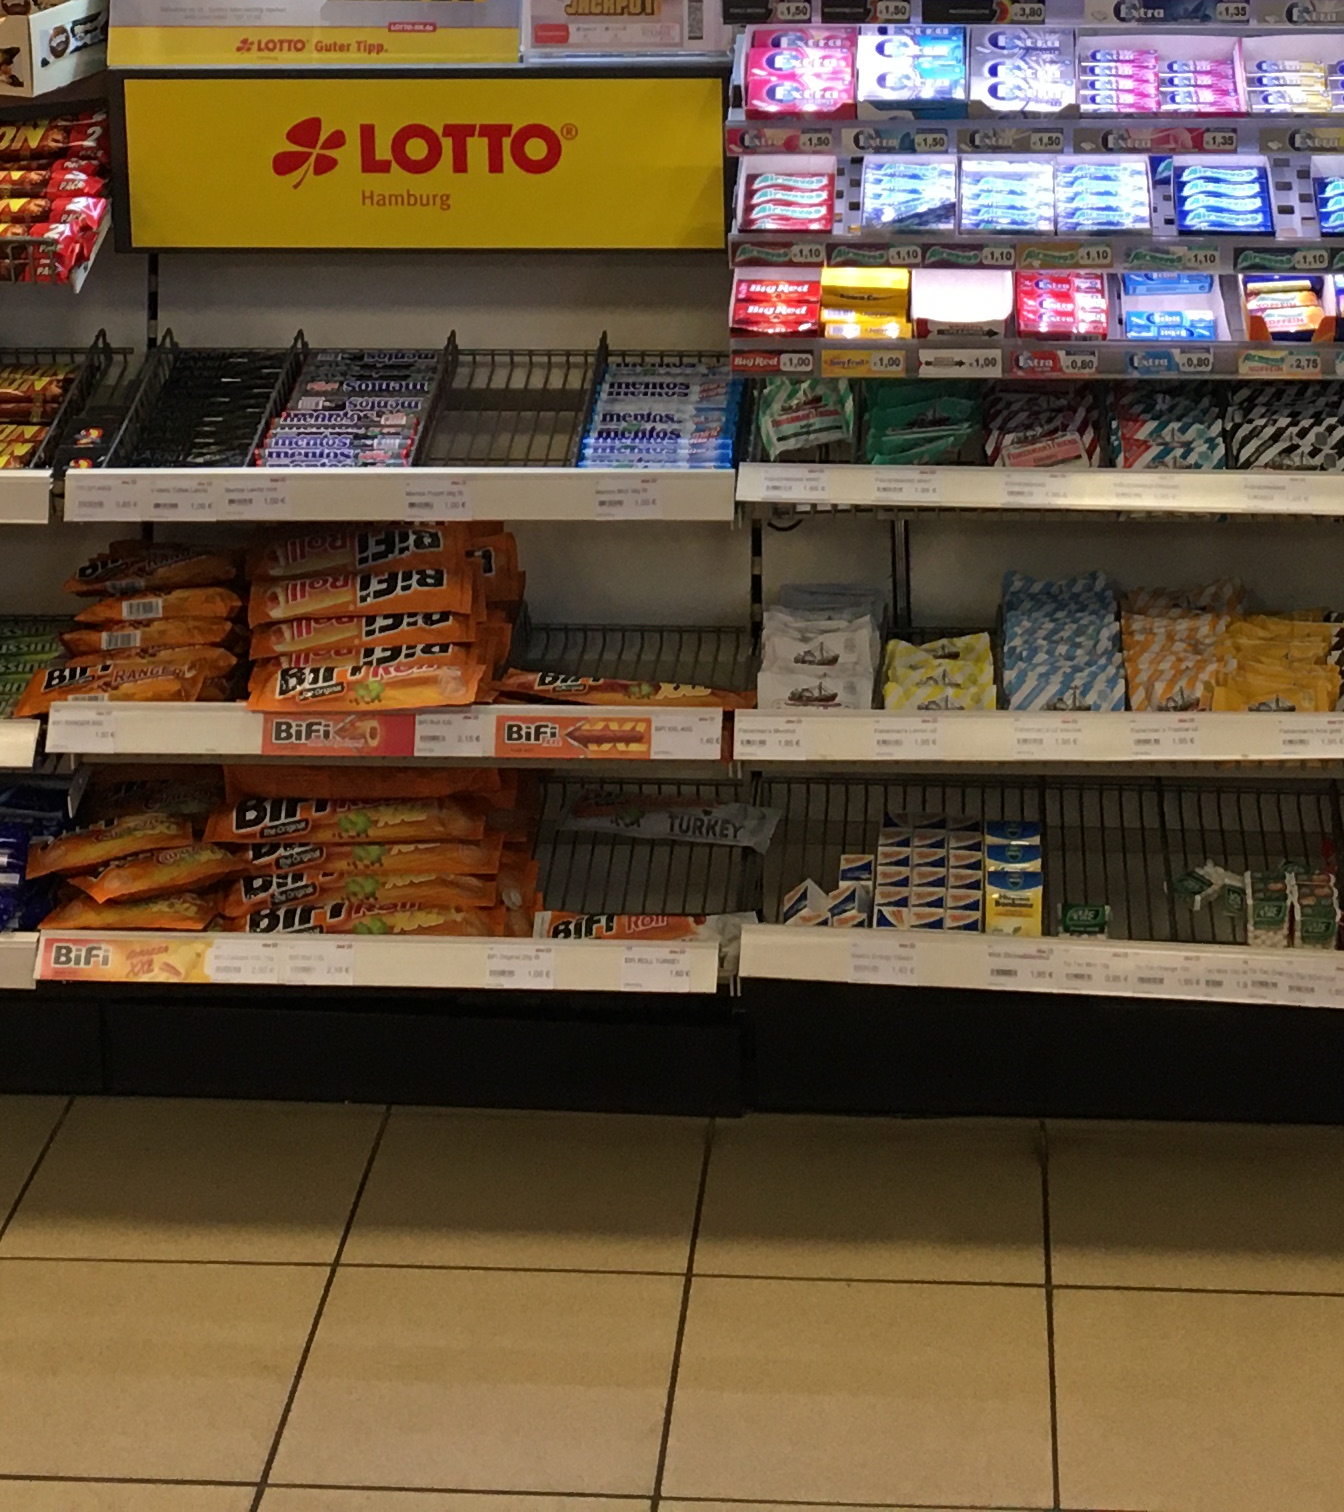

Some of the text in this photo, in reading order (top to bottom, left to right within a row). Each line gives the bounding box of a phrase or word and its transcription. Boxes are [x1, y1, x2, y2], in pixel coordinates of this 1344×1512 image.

[784, 5, 808, 18] 1,50
[1018, 6, 1043, 19] 3,80
[1223, 6, 1247, 19] 1,35
[256, 38, 389, 56] LOTTO Guter Tipp.
[360, 123, 562, 175] LOTTO
[361, 190, 452, 211] Hamburg
[787, 356, 811, 368] 1,00
[600, 412, 677, 425] mentos
[274, 721, 331, 742] BiFi
[505, 723, 557, 744] BiFi
[667, 814, 745, 840] TURKEY
[54, 945, 110, 967] BiFi
